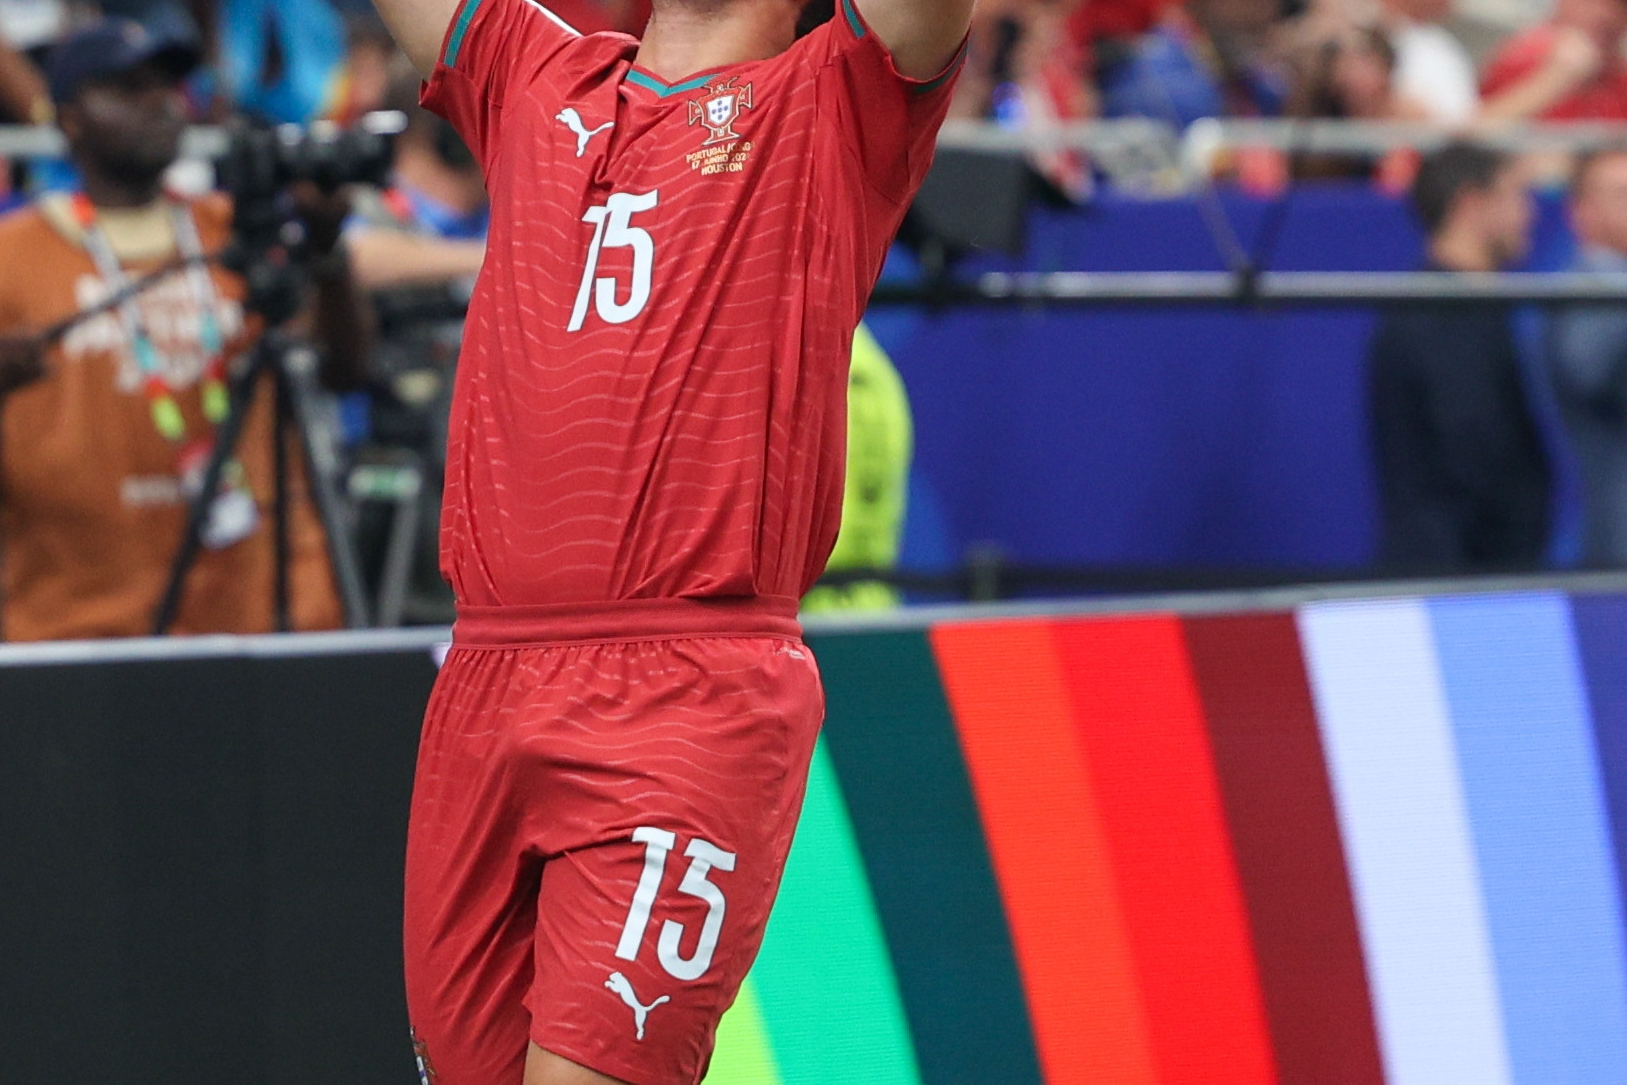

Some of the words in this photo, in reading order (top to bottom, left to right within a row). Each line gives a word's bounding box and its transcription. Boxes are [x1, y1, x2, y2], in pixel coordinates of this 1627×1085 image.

[691, 160, 701, 170] 17
[700, 162, 743, 175] HOUSTON
[566, 189, 658, 332] 15
[615, 827, 737, 981] 15
